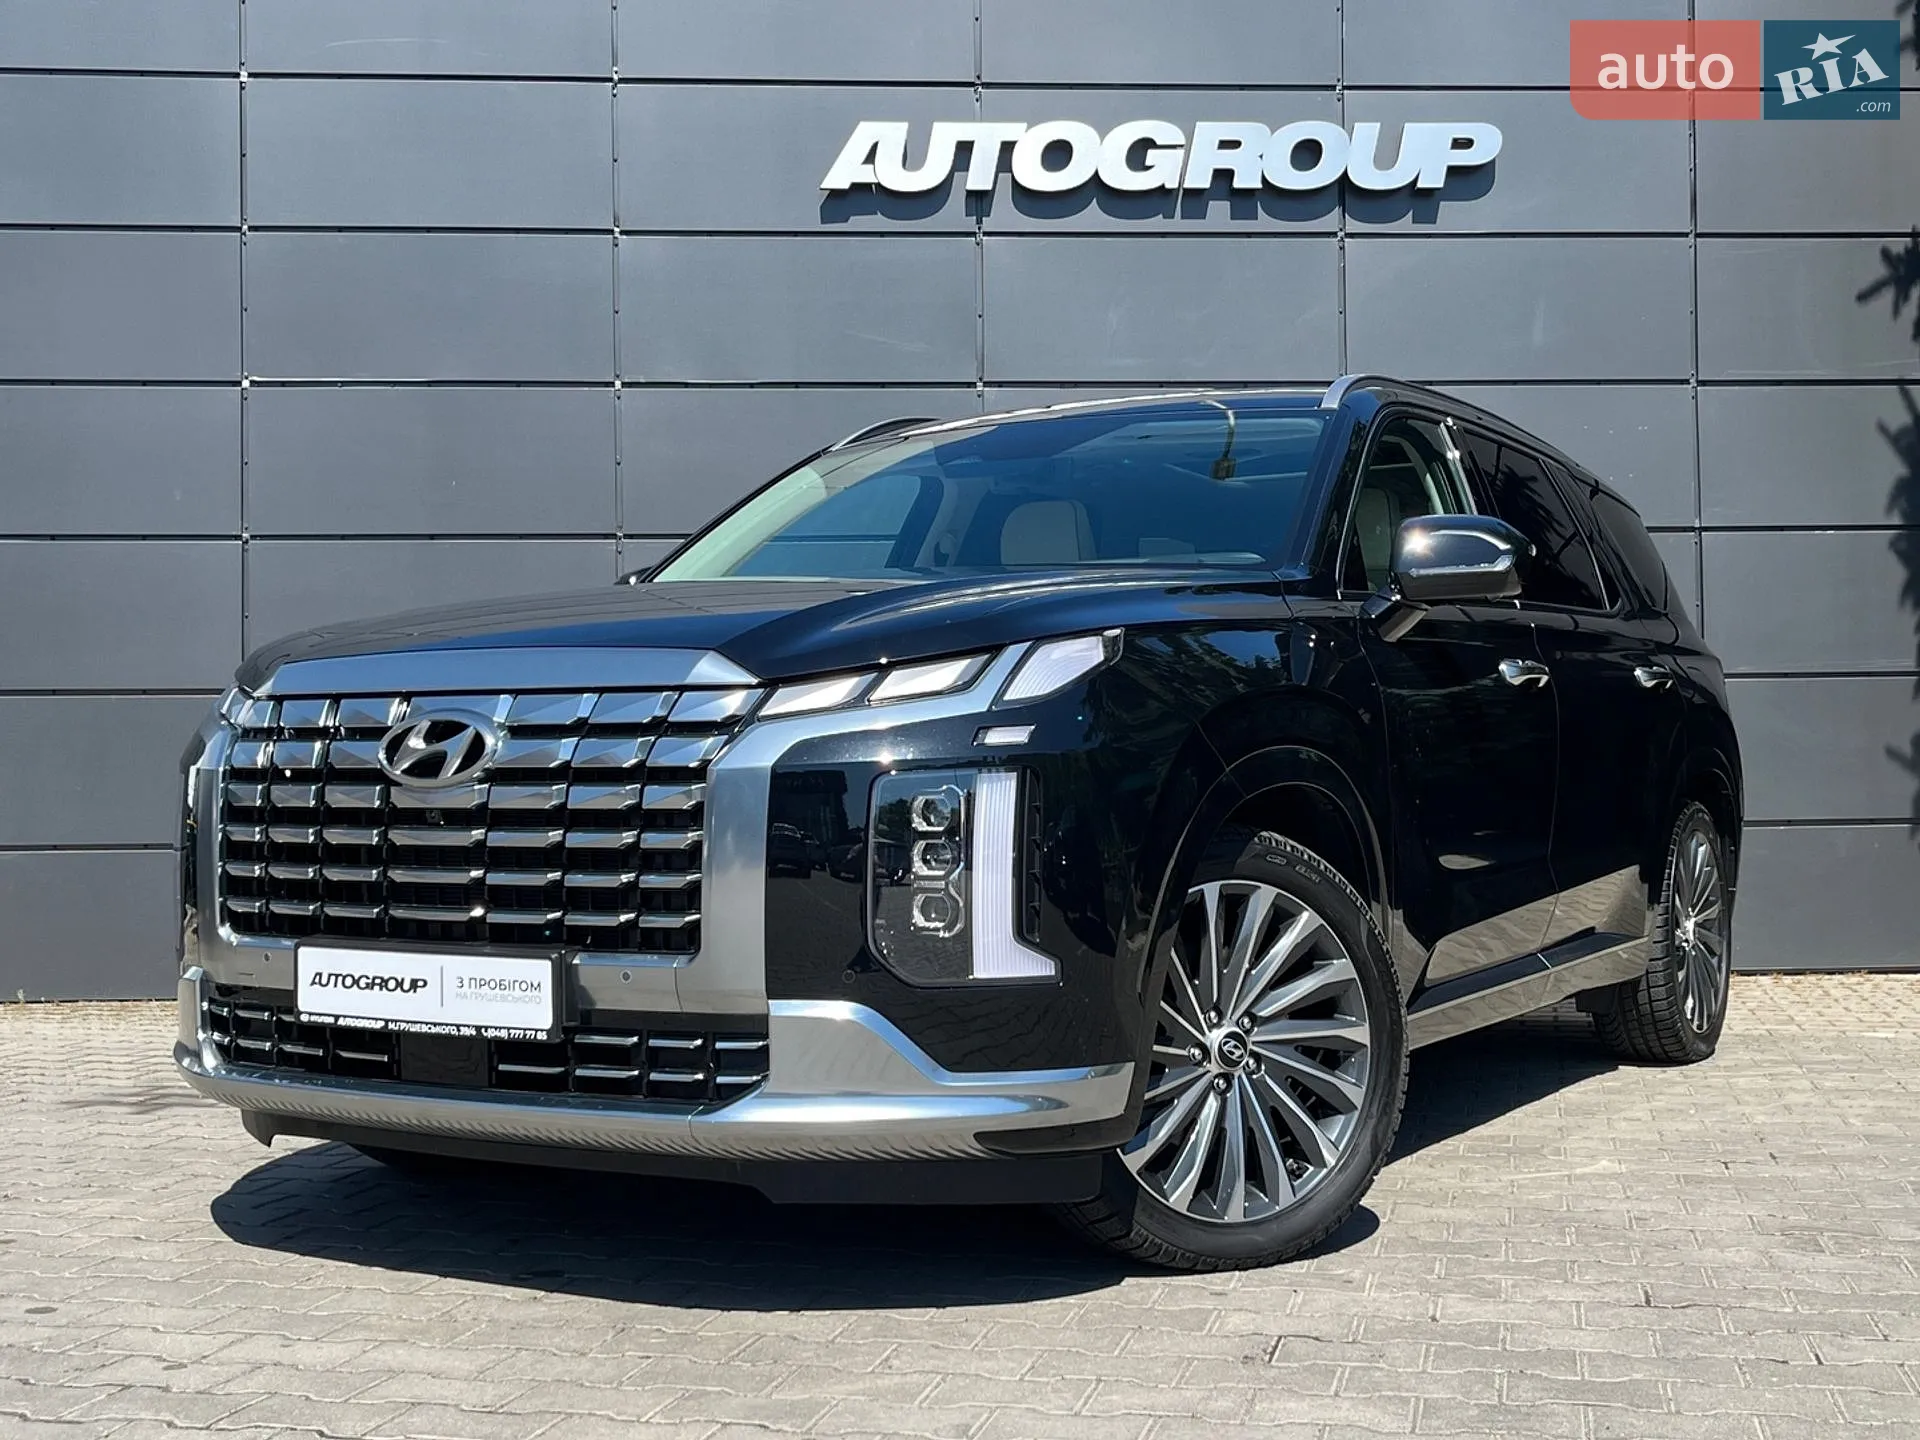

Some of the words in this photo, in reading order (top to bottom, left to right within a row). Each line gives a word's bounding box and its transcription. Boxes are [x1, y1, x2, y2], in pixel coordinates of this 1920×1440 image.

[820, 120, 1502, 192] AUTOGROUP
[310, 972, 428, 994] AUTOGROUP
[468, 977, 542, 993] ПРОБІГОМ
